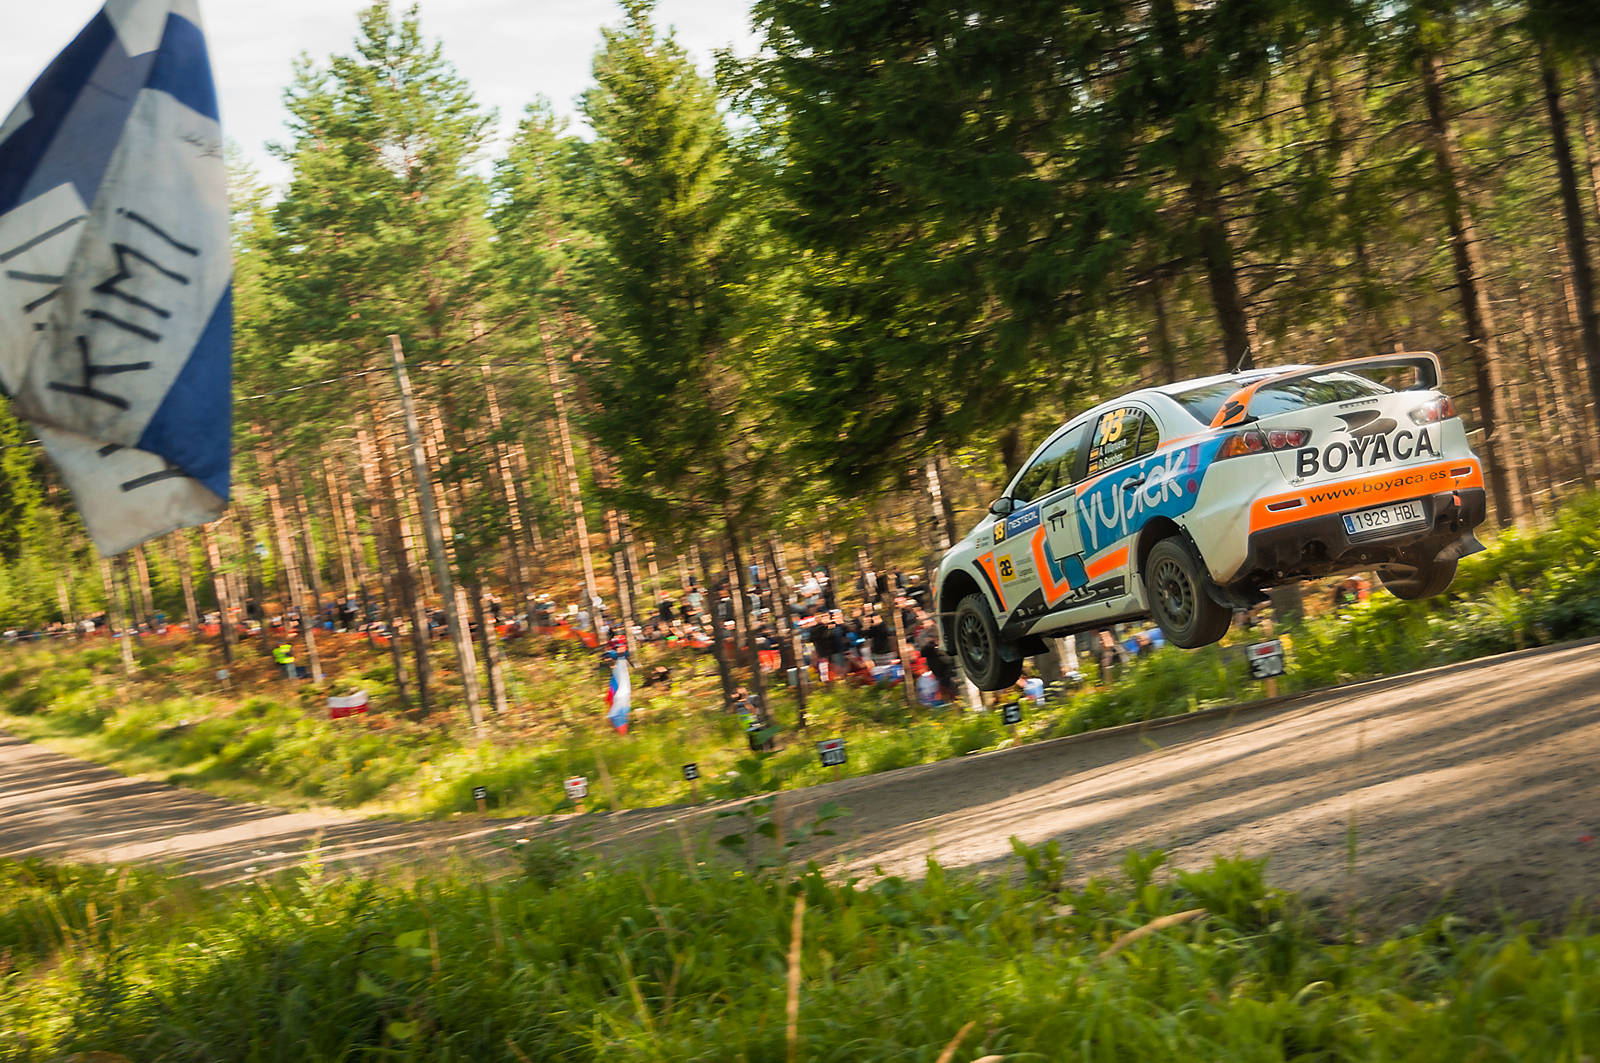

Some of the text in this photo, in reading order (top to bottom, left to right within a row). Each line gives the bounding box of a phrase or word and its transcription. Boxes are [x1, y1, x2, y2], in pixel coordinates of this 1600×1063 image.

[1100, 408, 1126, 446] 93
[1296, 428, 1434, 478] BOYACA
[1310, 470, 1446, 503] www.boyaca.es
[1356, 504, 1420, 529] 1929 HBL
[1252, 655, 1283, 678] 30
[1005, 705, 1021, 722] 5
[684, 765, 698, 779] 5
